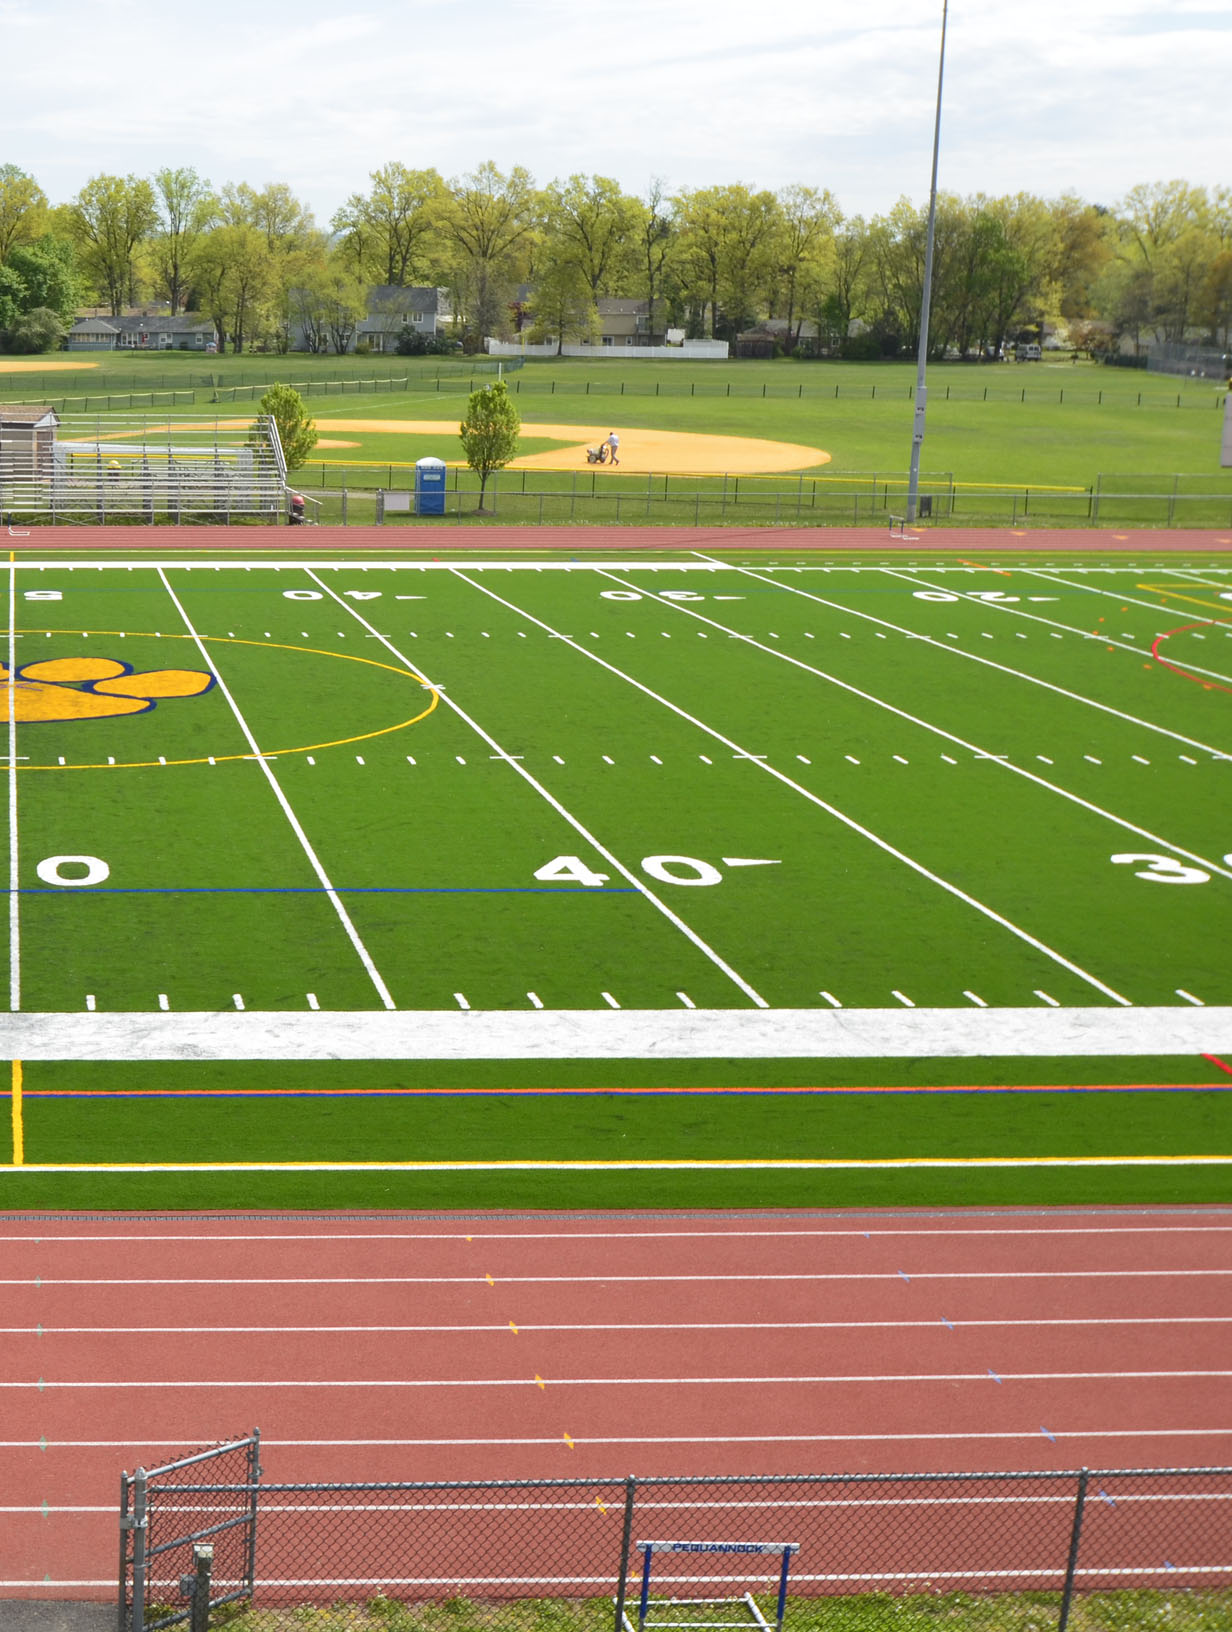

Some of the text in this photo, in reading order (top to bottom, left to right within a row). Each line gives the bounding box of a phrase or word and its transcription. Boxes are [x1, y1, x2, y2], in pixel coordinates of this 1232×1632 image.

[282, 590, 383, 601] 40
[599, 590, 705, 601] 30
[533, 855, 723, 887] 40
[672, 1543, 764, 1553] PEQUANNOCK
